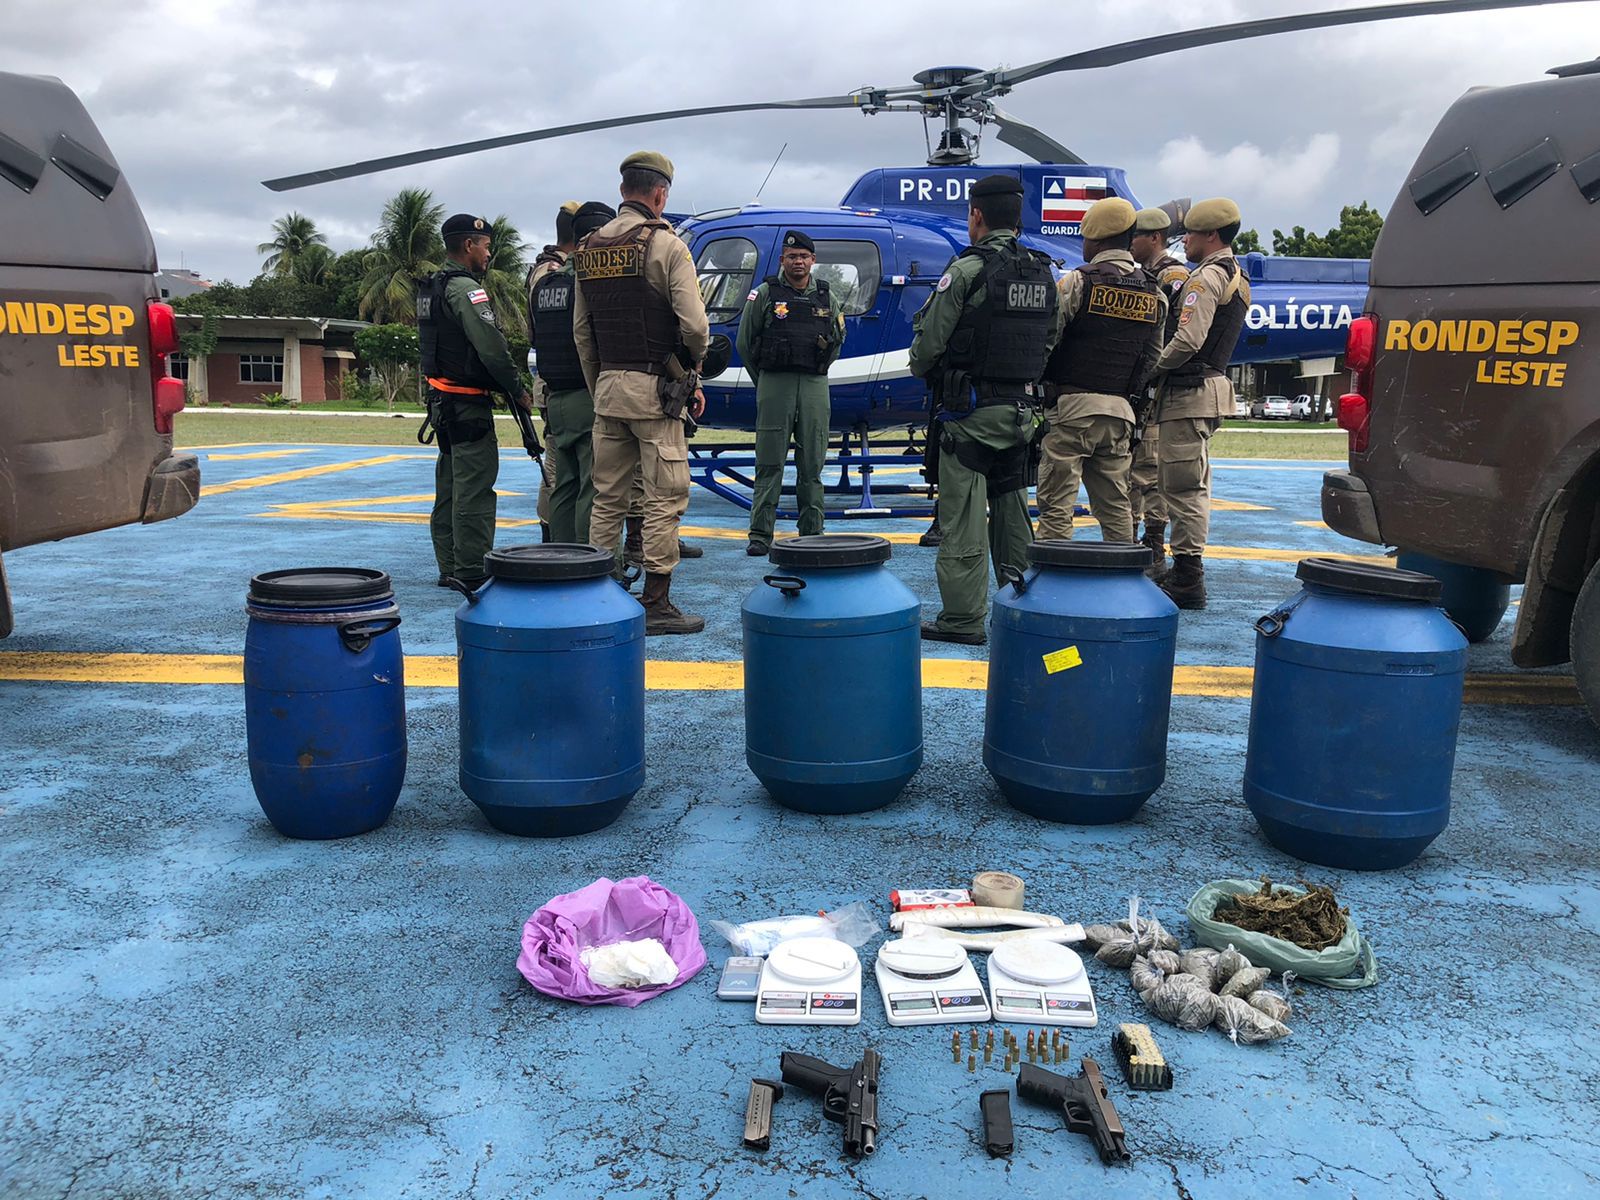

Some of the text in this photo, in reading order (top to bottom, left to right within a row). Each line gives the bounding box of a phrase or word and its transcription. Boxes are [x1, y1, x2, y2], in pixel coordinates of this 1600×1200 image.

[576, 247, 636, 271] RONDESP
[538, 288, 568, 308] GRAER
[1008, 284, 1047, 308] GRAER
[1093, 286, 1156, 313] RONDESP
[0, 301, 135, 336] NDESP
[1244, 297, 1352, 330] OLÍCIA
[1385, 319, 1579, 355] RONDESP
[57, 344, 140, 367] LESTE
[1476, 360, 1567, 387] LESTE
